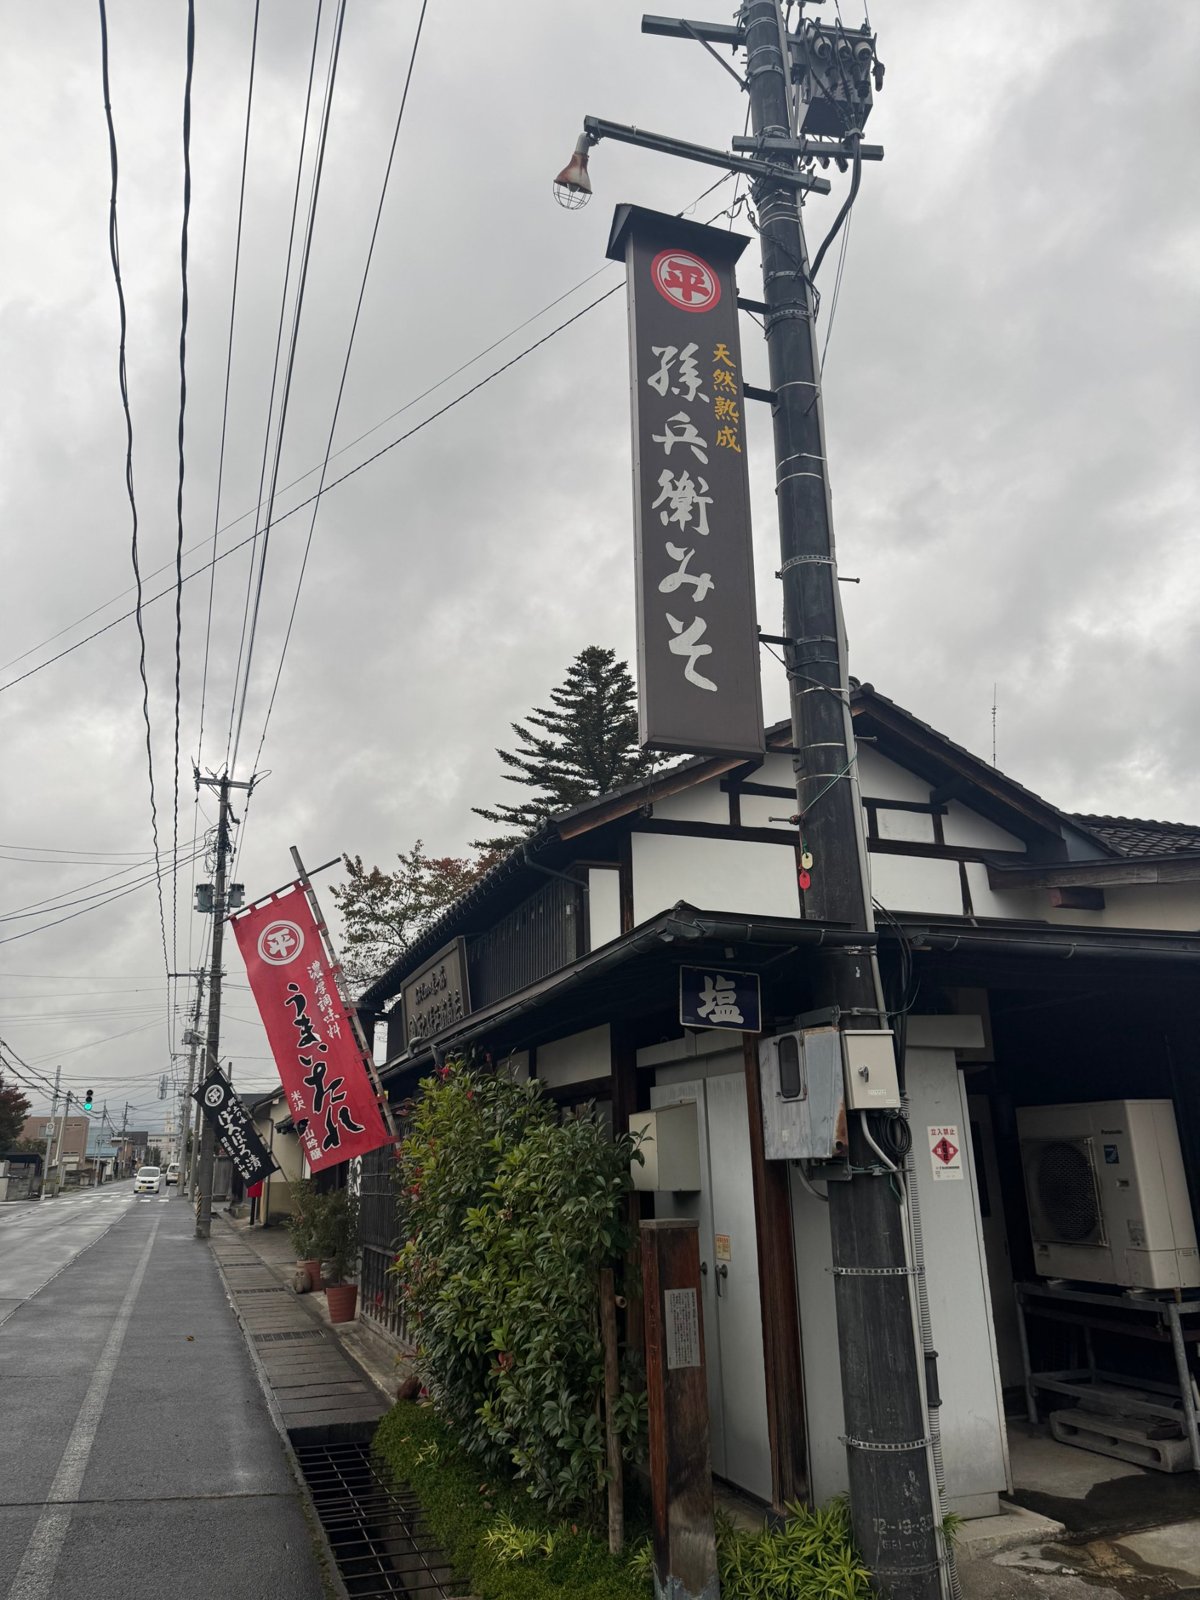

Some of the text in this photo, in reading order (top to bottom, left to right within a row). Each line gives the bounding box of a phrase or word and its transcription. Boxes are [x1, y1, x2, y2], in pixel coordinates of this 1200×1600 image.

[712, 343, 742, 453] 天然熟成
[647, 342, 719, 692] 孫兵衛みそ
[307, 960, 341, 1039] 濃厚調味料
[696, 974, 744, 1024] 塩
[284, 982, 366, 1151] うまいたれ
[291, 1089, 323, 1161] 米沢 山吟醸
